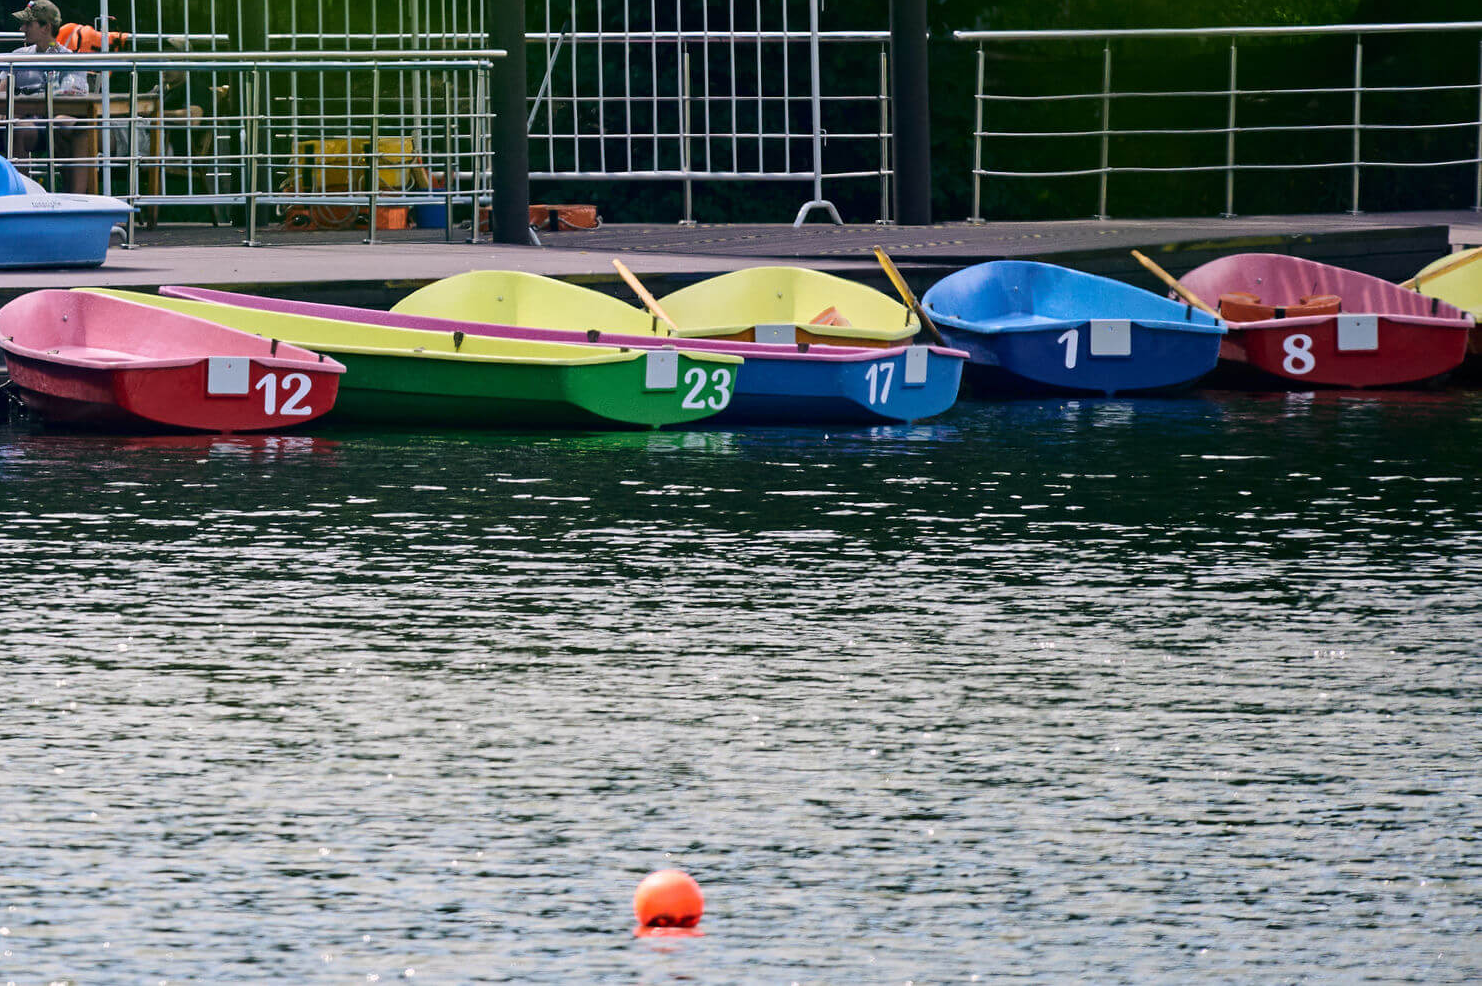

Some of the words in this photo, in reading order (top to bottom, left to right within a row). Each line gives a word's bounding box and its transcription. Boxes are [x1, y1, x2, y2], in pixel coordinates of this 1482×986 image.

[1057, 328, 1079, 369] 1
[1282, 333, 1316, 375] 8
[255, 372, 312, 416] 12
[681, 367, 731, 410] 23
[864, 361, 895, 405] 17
